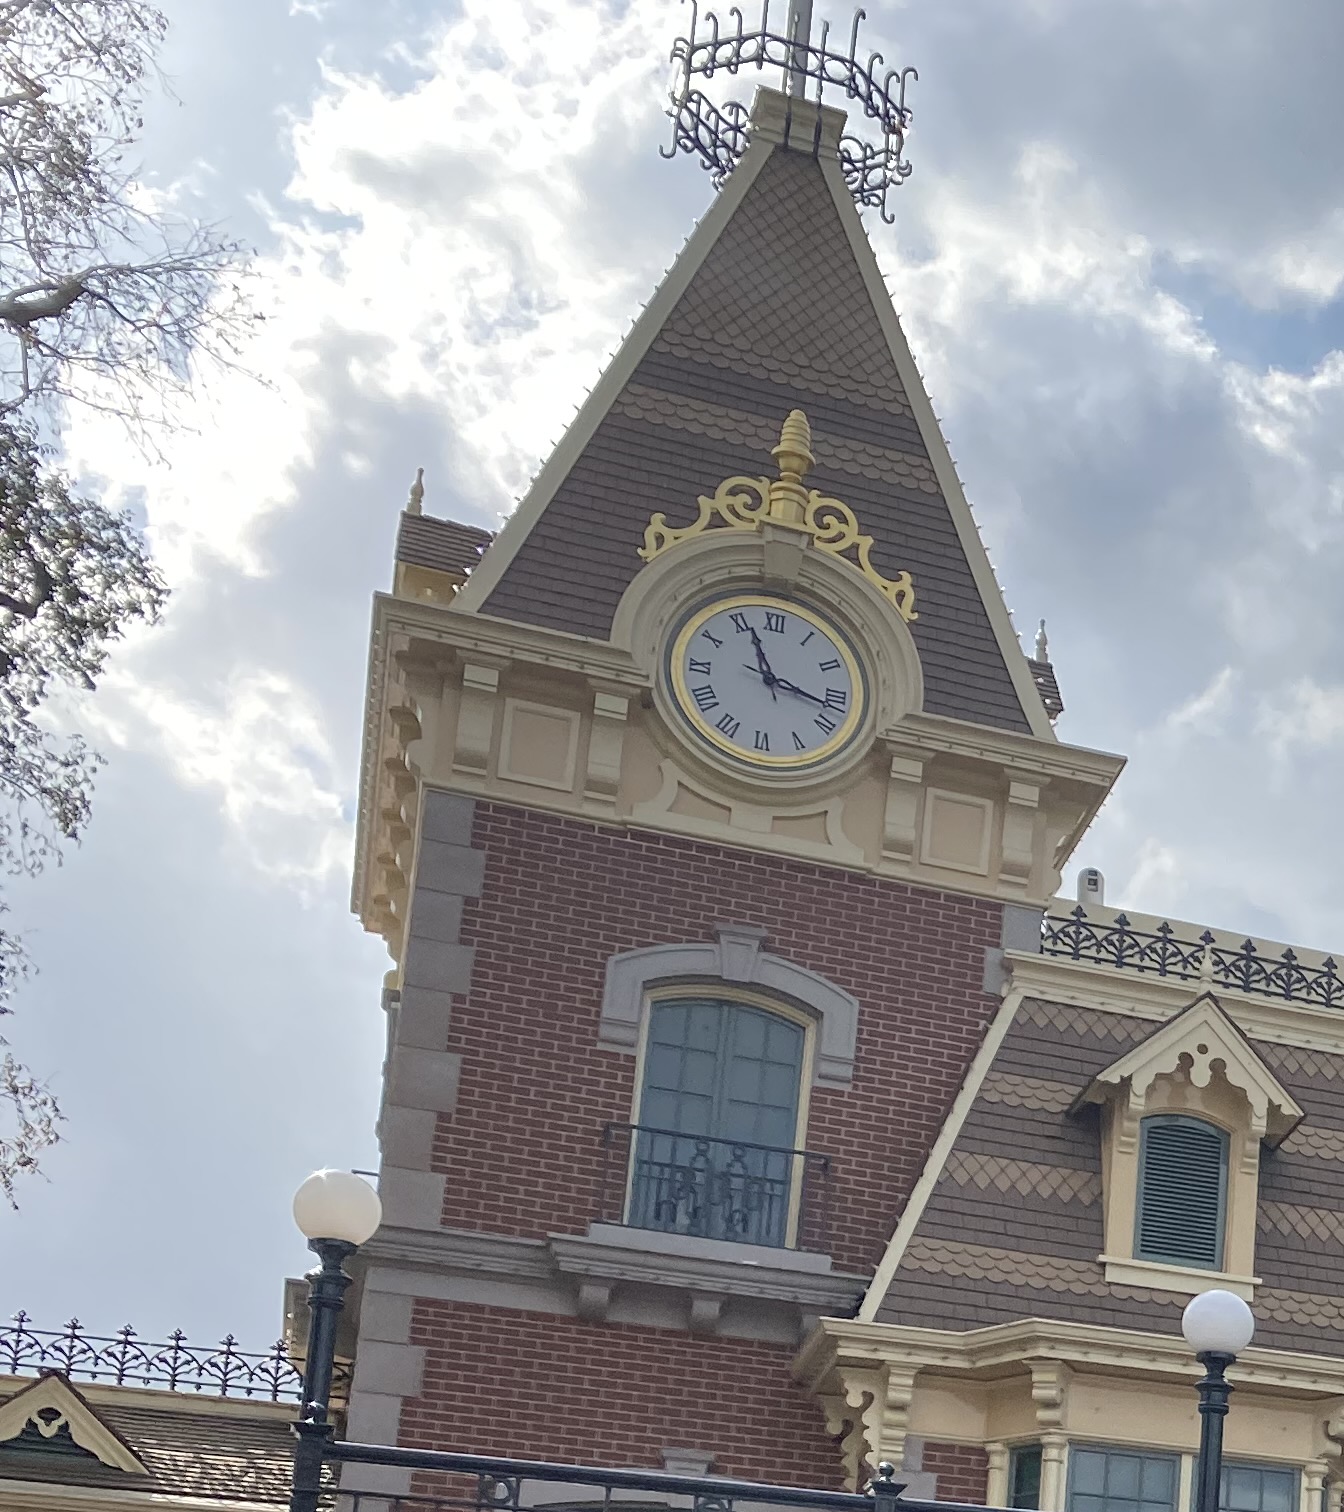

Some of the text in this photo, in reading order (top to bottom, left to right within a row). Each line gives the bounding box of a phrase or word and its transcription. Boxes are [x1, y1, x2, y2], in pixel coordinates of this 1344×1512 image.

[764, 611, 786, 634] XII
[702, 630, 723, 648] X
[689, 658, 711, 675] IX
[819, 659, 841, 672] II
[691, 685, 719, 712] VIII
[715, 713, 740, 738] VII
[814, 713, 836, 736] IV
[754, 730, 770, 752] VI
[792, 731, 806, 750] V
